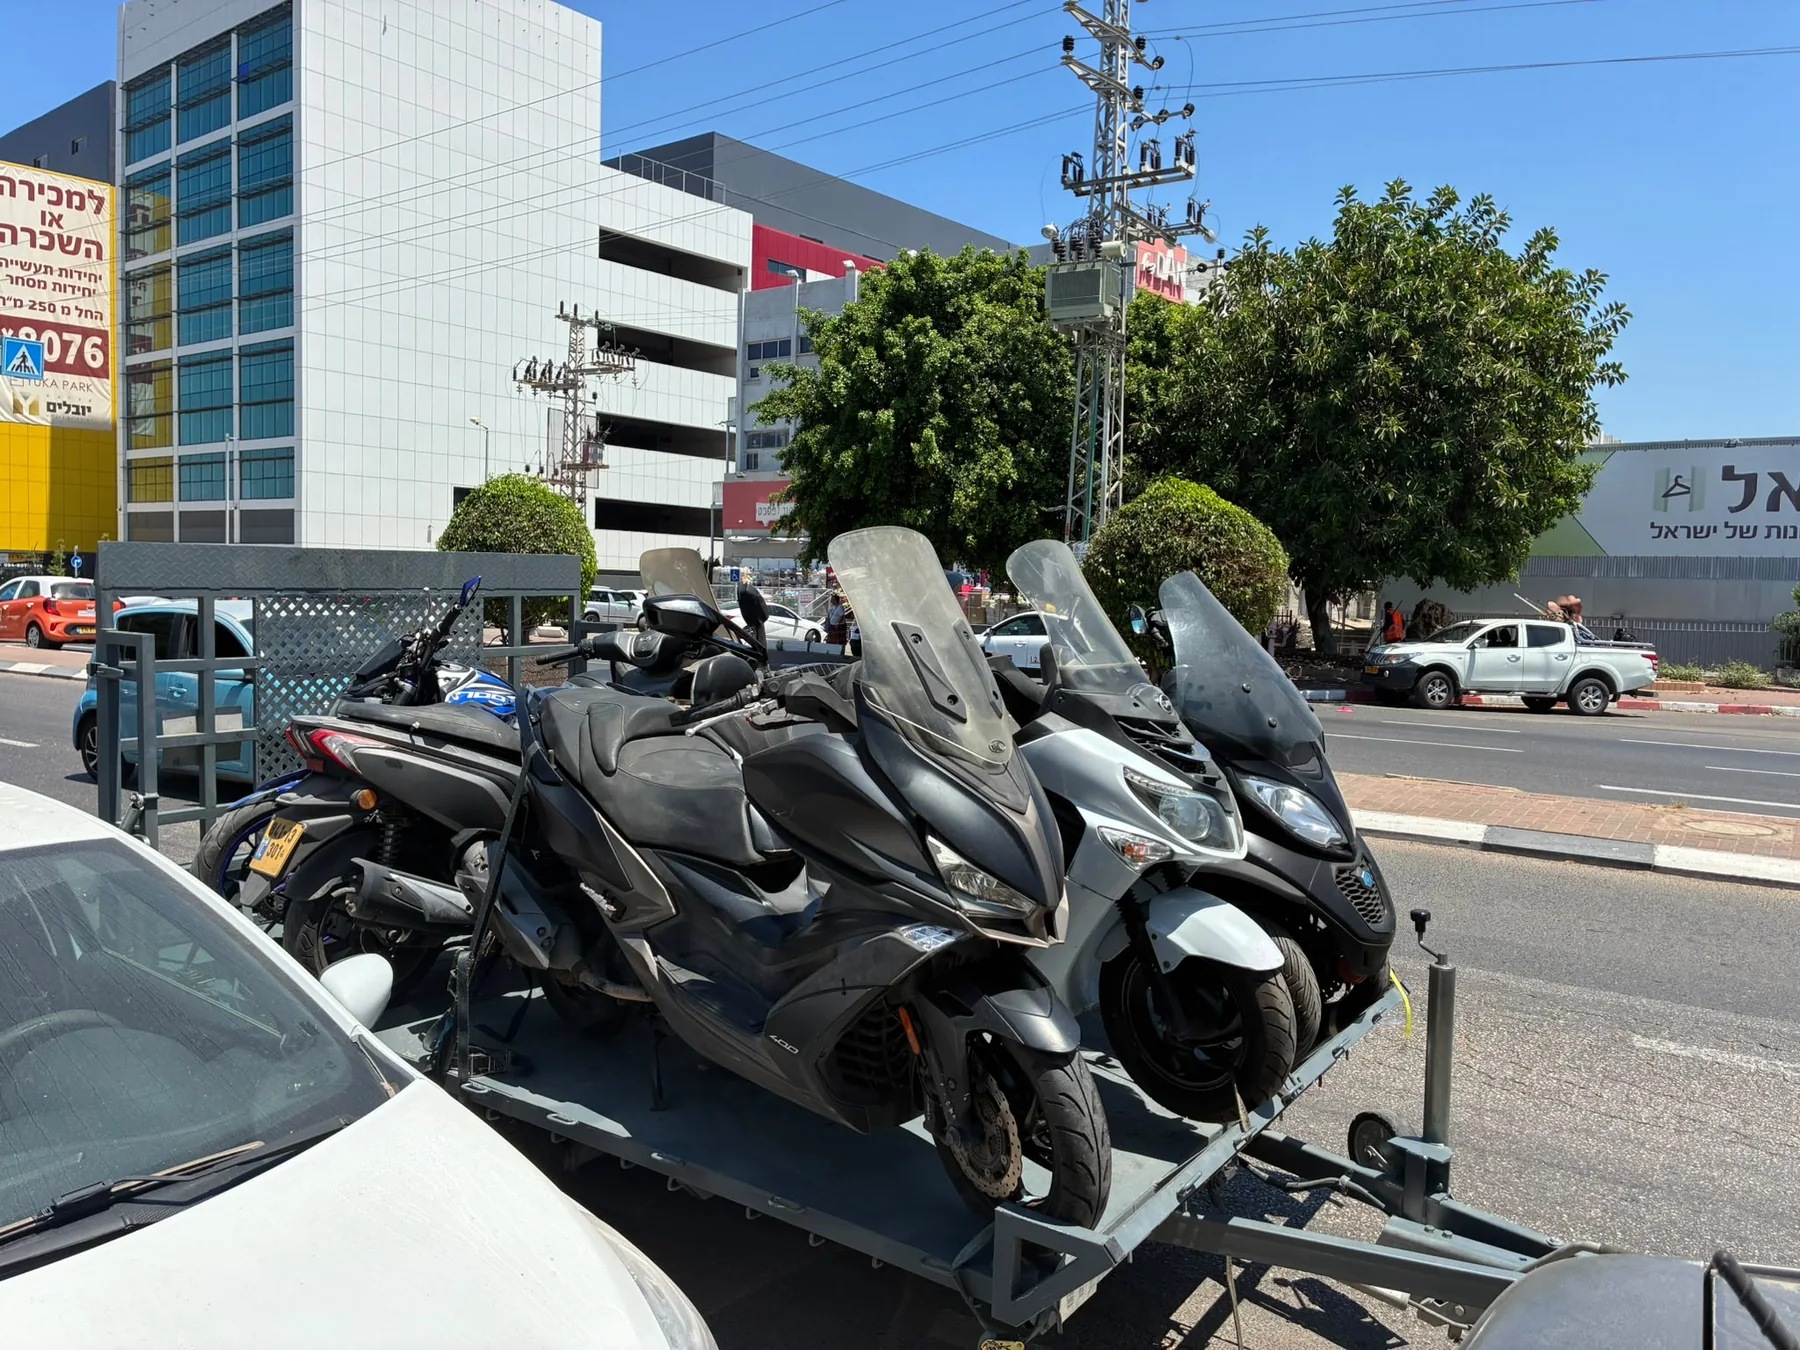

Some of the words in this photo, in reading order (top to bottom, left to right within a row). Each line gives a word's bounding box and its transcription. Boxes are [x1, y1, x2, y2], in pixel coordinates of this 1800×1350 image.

[0, 175, 105, 215] למכירה
[41, 210, 64, 230] או
[0, 223, 103, 261] השכרה
[0, 257, 53, 276] תעשייה
[5, 273, 47, 290] מסחר
[58, 267, 102, 284] יחידות
[52, 281, 96, 298] יחידות
[28, 299, 56, 314] 250
[61, 305, 71, 316] מ
[75, 305, 104, 321] החל
[62, 380, 93, 393] PARK
[46, 401, 92, 416] יובלים
[1649, 521, 1717, 539] ישראל
[1723, 521, 1758, 539] של
[1764, 525, 1800, 539] נות
[769, 1034, 799, 1055] 400
